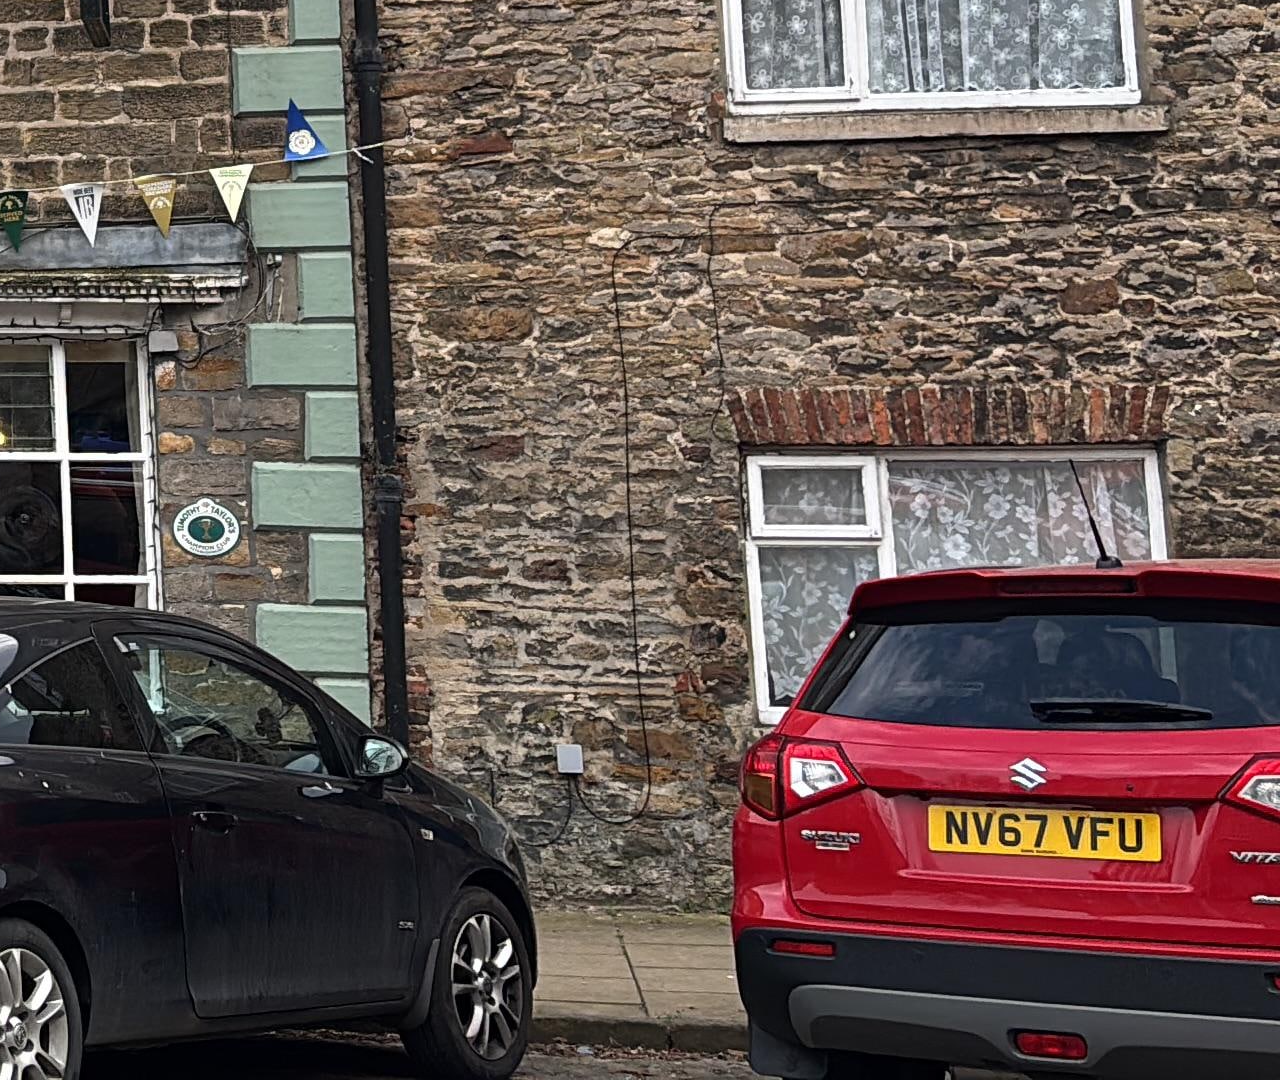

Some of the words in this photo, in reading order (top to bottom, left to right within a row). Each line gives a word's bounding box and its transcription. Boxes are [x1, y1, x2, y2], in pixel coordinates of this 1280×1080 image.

[177, 506, 200, 532] TIMOTHY
[945, 811, 1049, 849] NV67
[1062, 816, 1144, 853] VFU
